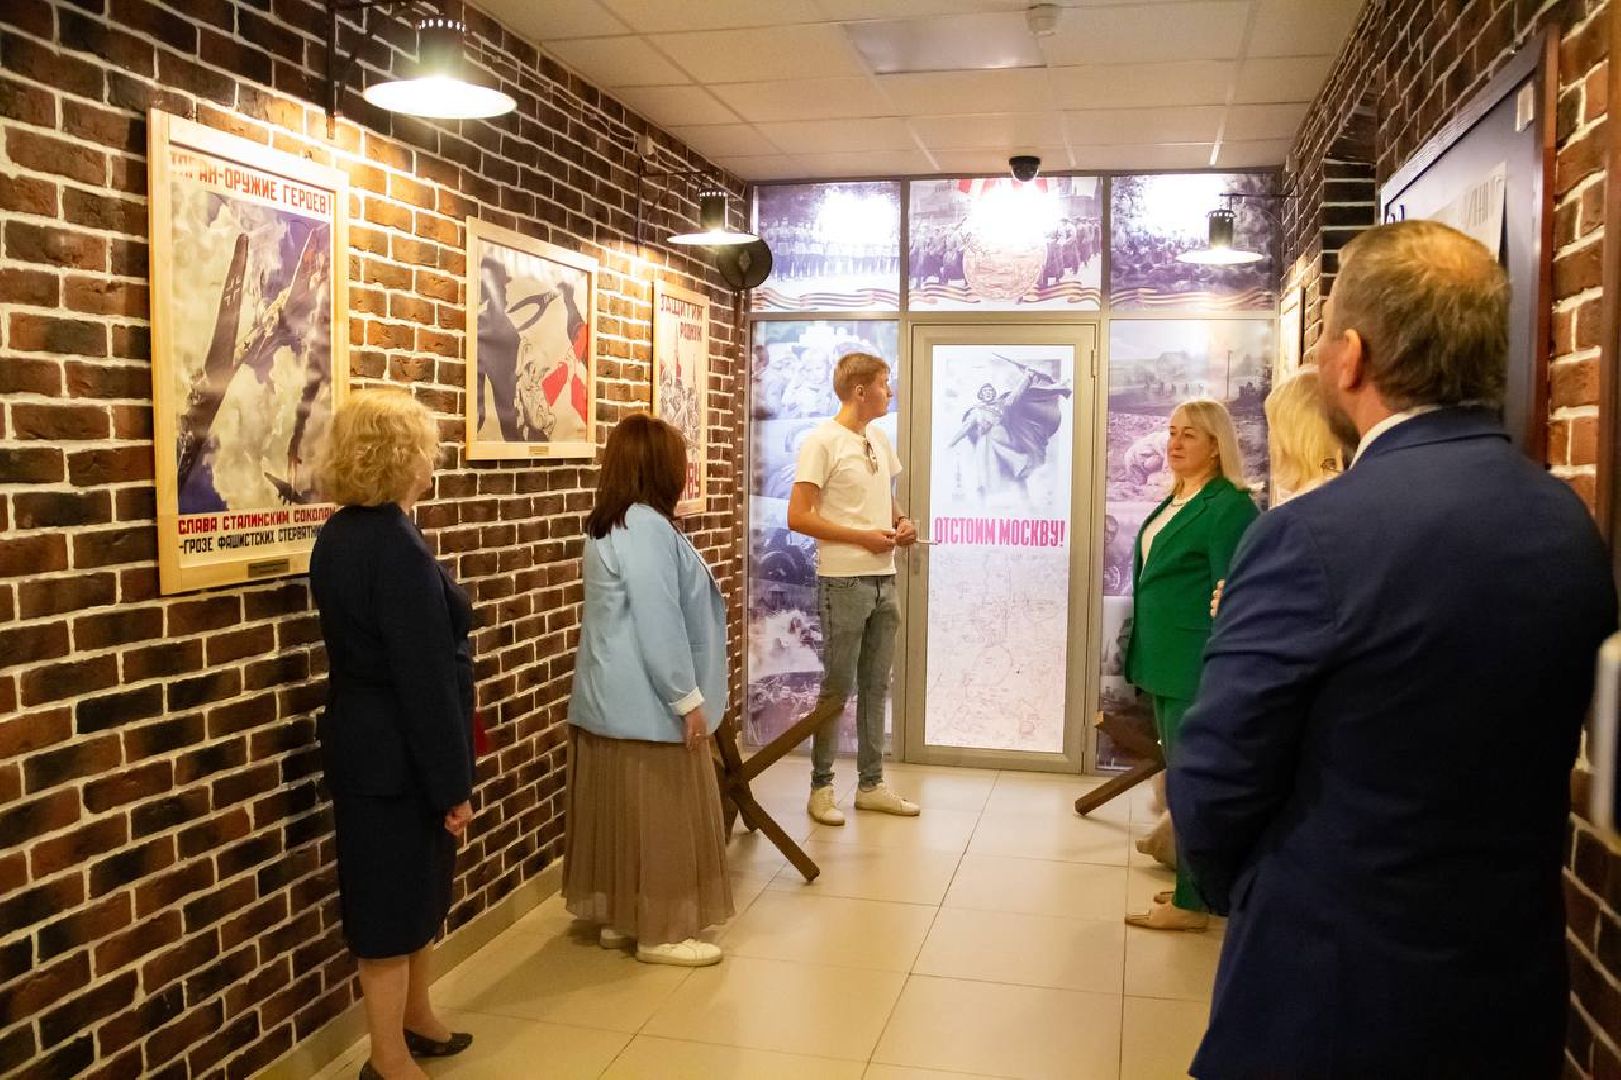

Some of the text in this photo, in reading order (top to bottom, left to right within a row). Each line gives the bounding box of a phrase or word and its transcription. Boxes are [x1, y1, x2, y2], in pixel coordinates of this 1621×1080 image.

[178, 516, 217, 535] СЛАВА
[223, 510, 290, 531] СТАЛИНСКИМ
[935, 517, 1065, 547] ОТСТОИМ МОСКВУ!
[218, 530, 275, 551] ФАШИСТСКИХ
